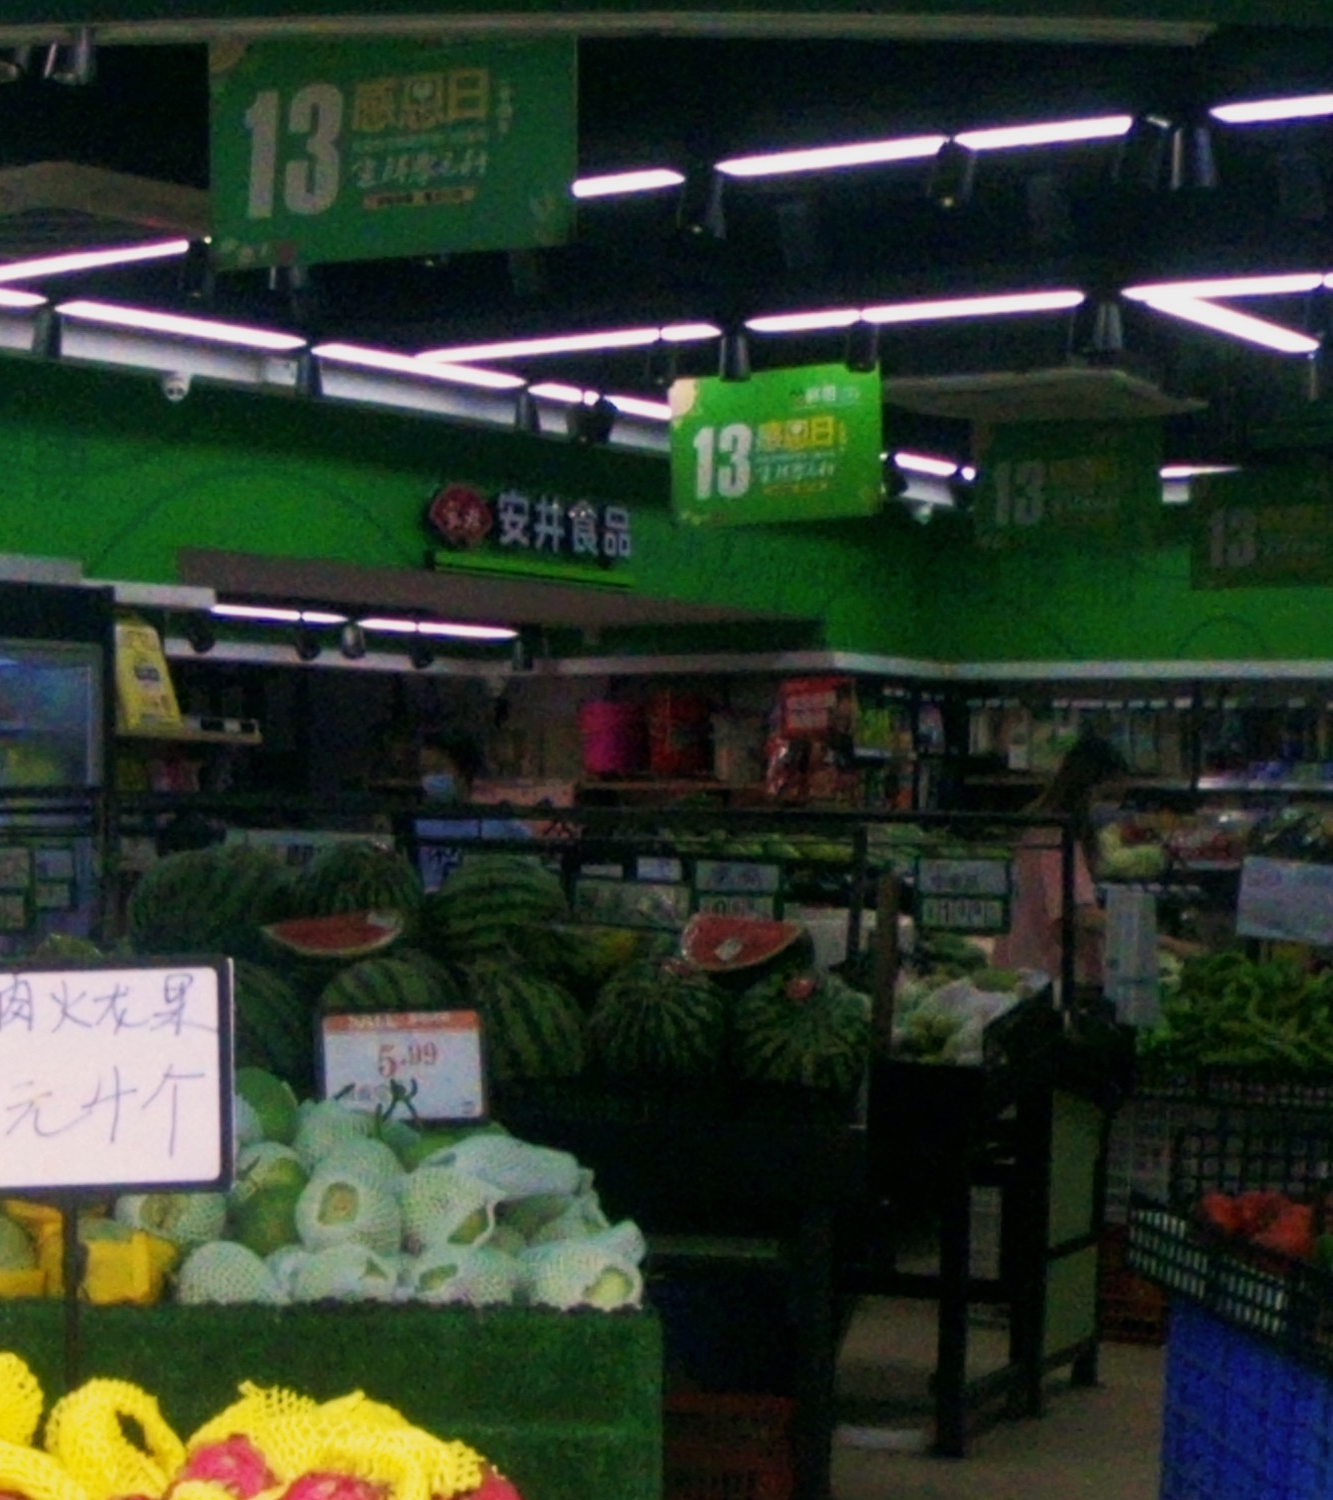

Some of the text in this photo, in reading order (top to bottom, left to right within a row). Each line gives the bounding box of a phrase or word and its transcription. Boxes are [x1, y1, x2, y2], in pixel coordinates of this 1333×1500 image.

[244, 82, 345, 220] 13
[692, 422, 753, 500] 13
[496, 488, 633, 558] 安井食品
